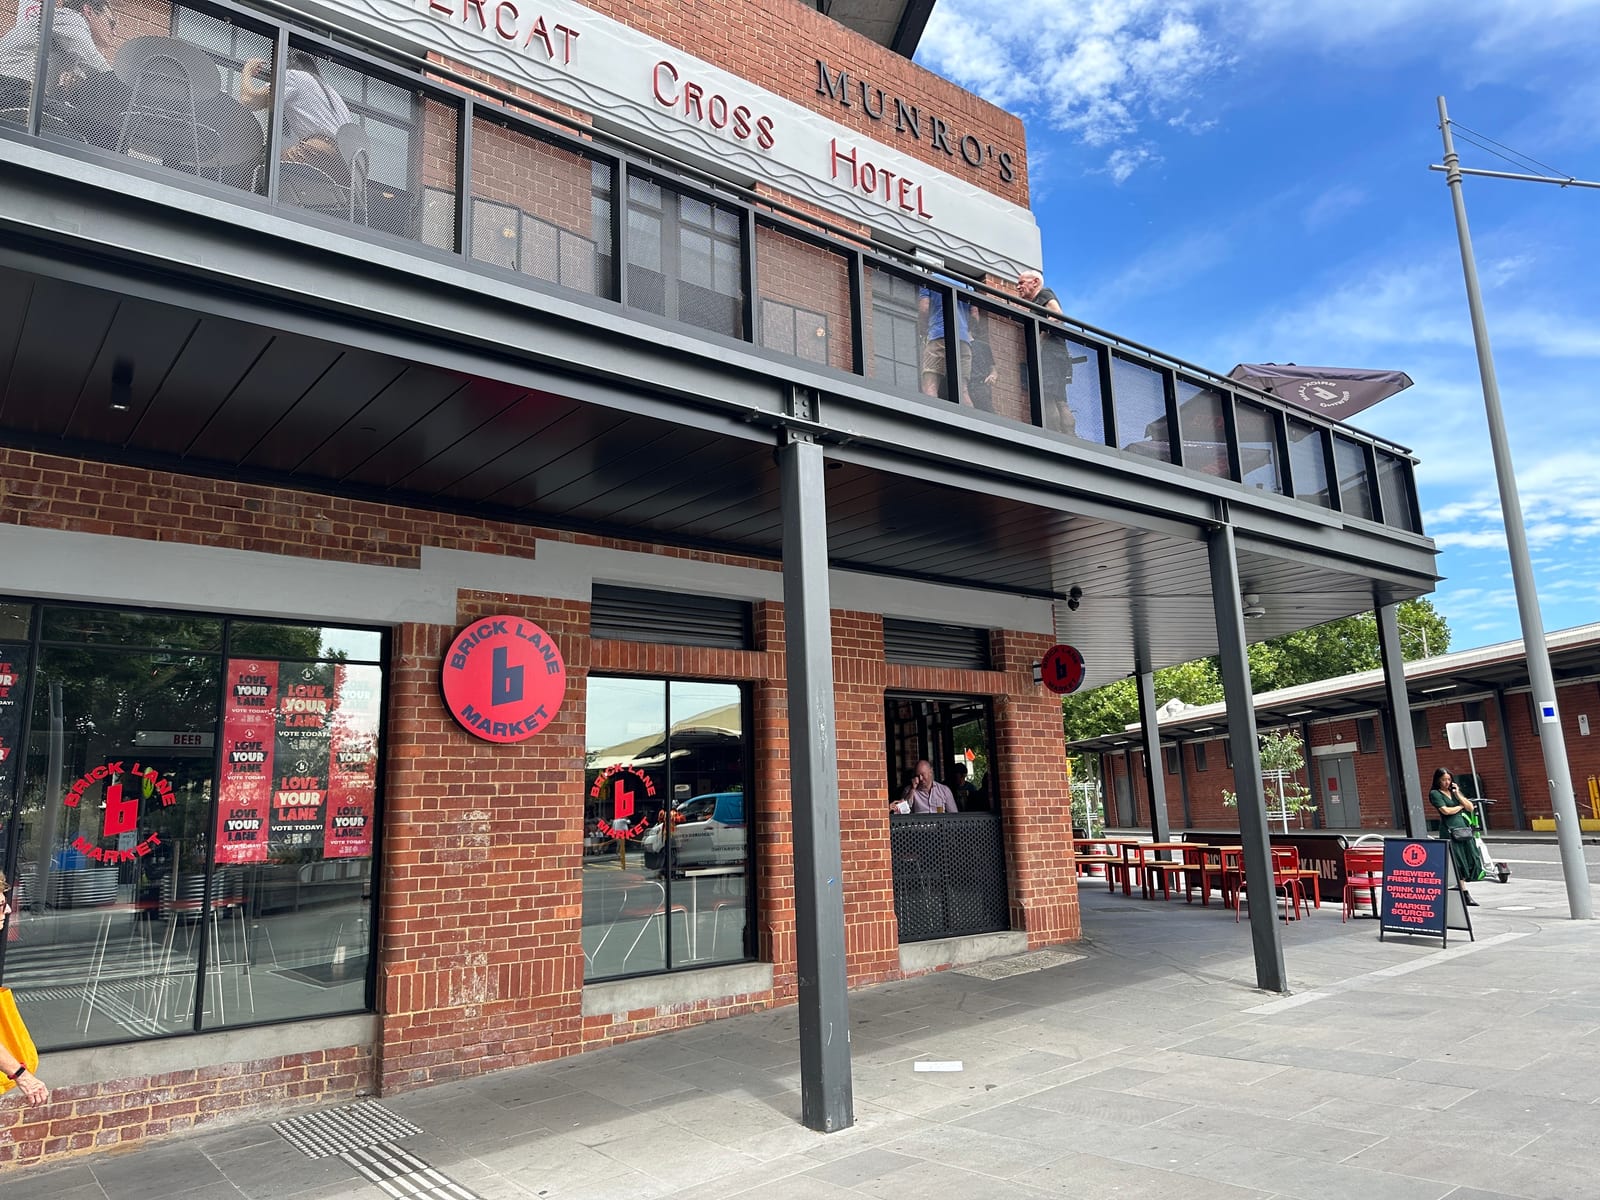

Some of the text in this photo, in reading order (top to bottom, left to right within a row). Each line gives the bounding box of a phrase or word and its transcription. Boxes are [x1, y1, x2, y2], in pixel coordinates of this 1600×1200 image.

[429, 0, 933, 219] RCAT CROSS HOTEL
[816, 60, 1014, 183] MUNRO'S
[450, 621, 560, 675] BRICK LANE
[238, 674, 267, 685] LOVE
[236, 685, 268, 696] YOUR
[236, 697, 266, 706] LANE
[285, 698, 327, 713] YOUR
[460, 703, 548, 736] MARKET
[173, 734, 202, 745] BEER
[232, 752, 265, 762] YOUR
[64, 761, 177, 808] BRICK LANE
[281, 776, 319, 789] LOVE
[590, 763, 656, 798] BRICK LANE
[279, 792, 321, 806] YOUR
[230, 809, 258, 818] LOVE
[278, 807, 318, 821] LANE
[337, 806, 363, 816] LOVE
[227, 820, 260, 830] YOUR
[335, 817, 364, 827] YOUR
[335, 828, 363, 837] LANE
[597, 816, 650, 839] MARKET
[227, 832, 257, 841] LANE
[72, 832, 162, 863] MARKET
[1393, 869, 1436, 878] BREWERY
[1386, 875, 1442, 885] FRESH BEER
[1386, 885, 1415, 893] DRINK
[1391, 892, 1437, 901] TAKEAWAY
[1394, 902, 1432, 911] MARKET
[1391, 908, 1435, 918] SOURCED
[1401, 915, 1424, 924] EATS
